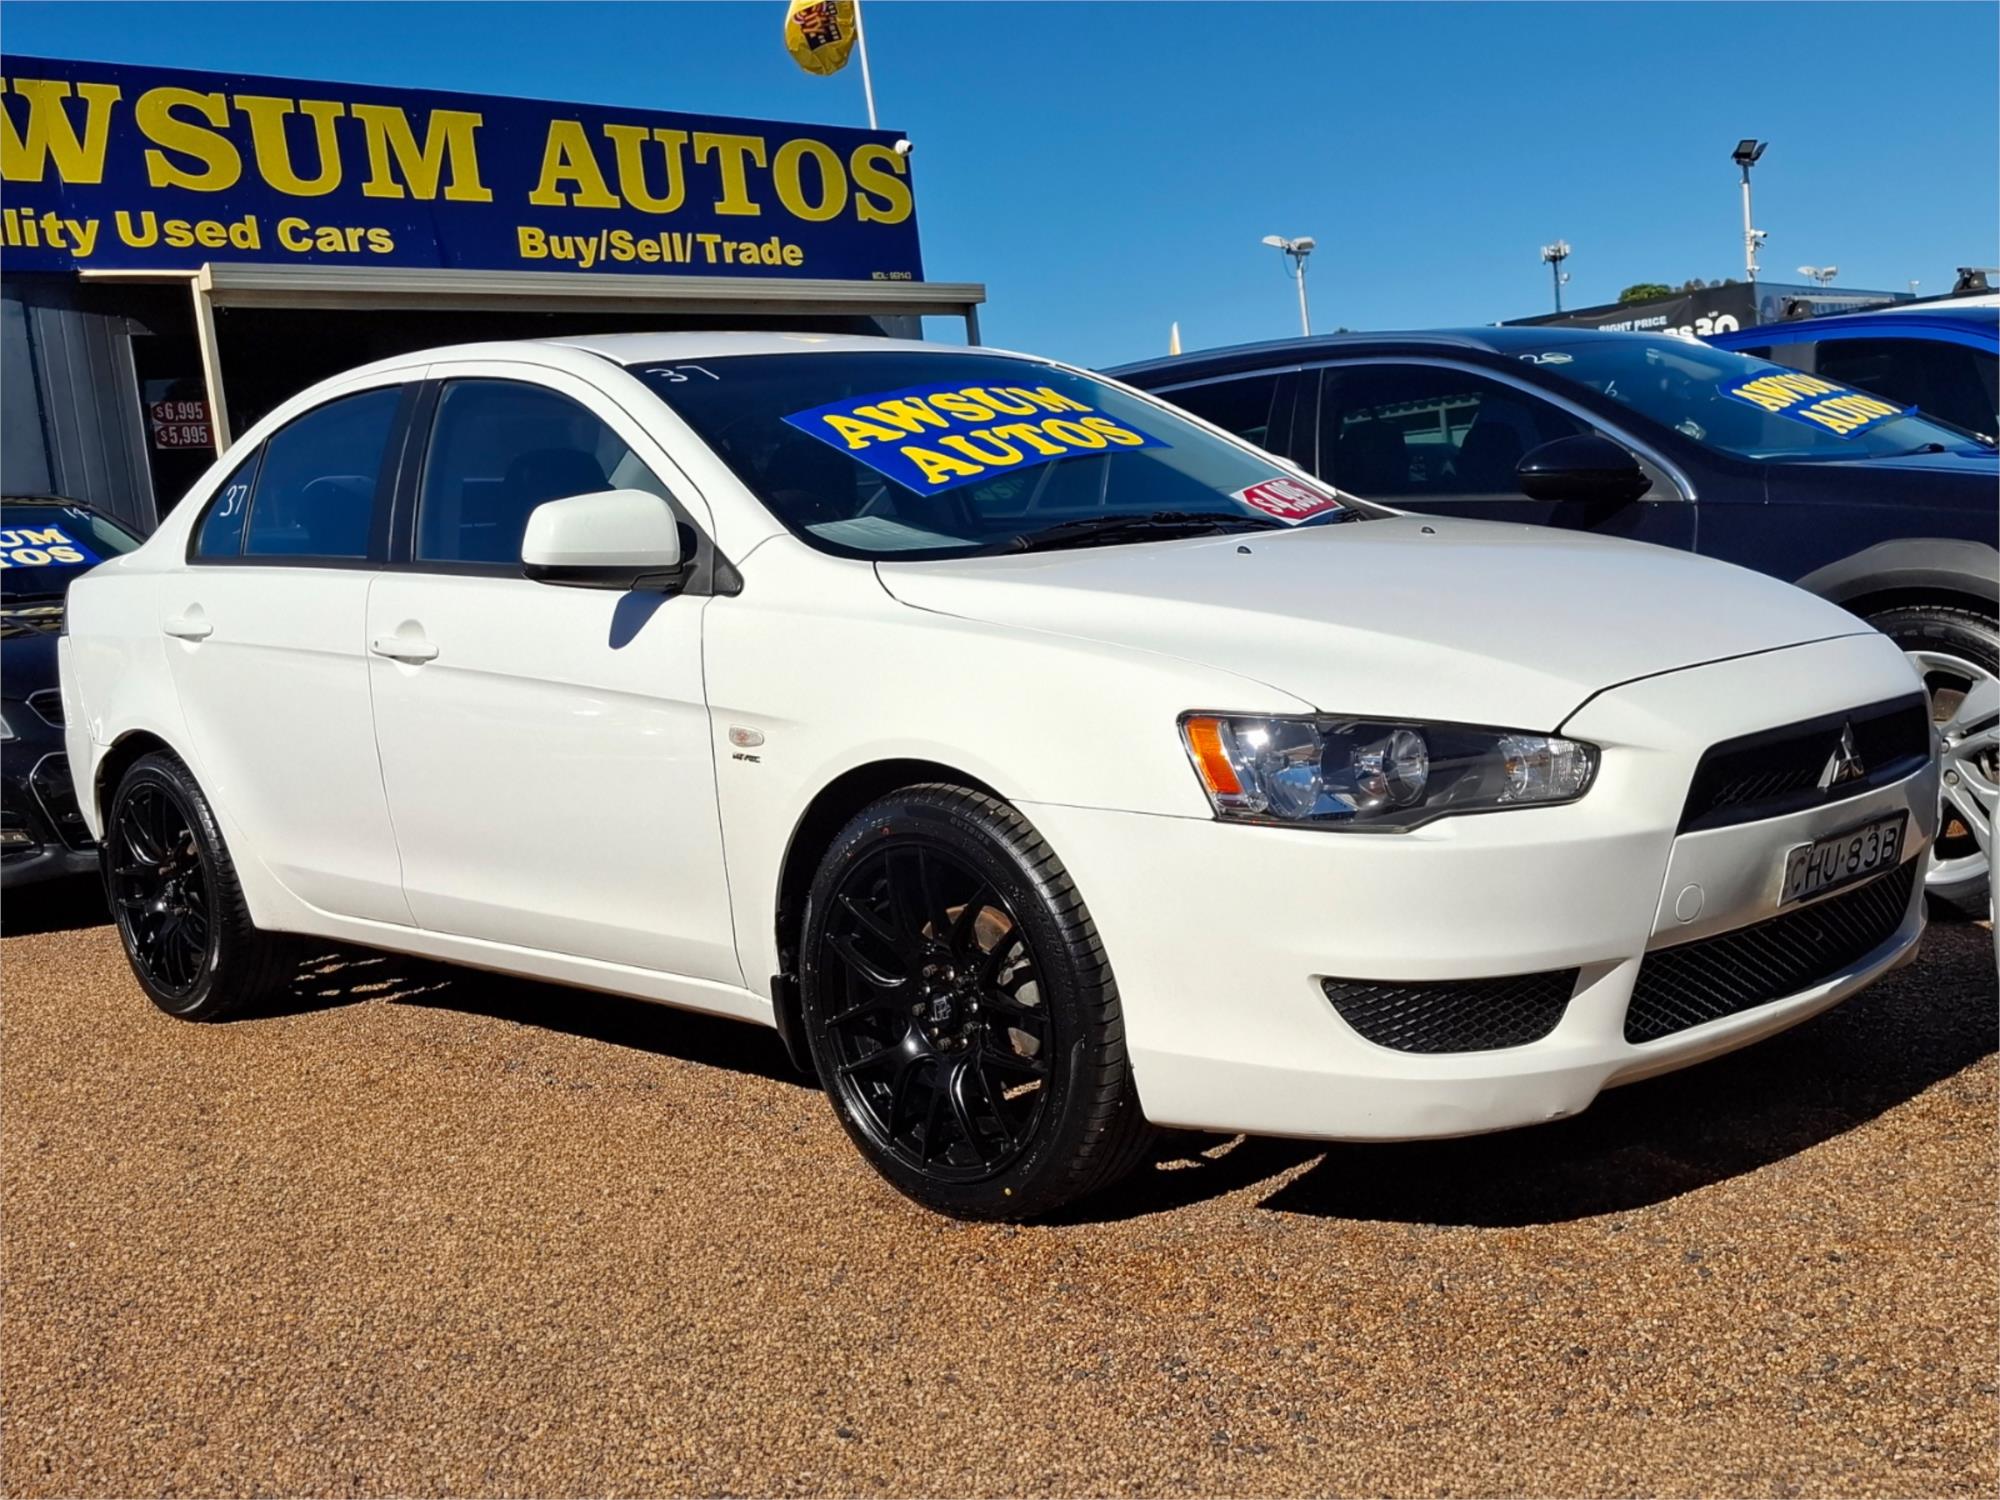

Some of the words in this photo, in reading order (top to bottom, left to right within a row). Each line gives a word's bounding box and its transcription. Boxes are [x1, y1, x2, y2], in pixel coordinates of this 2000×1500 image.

[529, 119, 913, 225] AUTOS
[1, 207, 99, 257] lity
[115, 210, 261, 250] Used
[277, 216, 395, 254] Cars
[517, 226, 804, 268] Buy/Sell/Trade
[1634, 315, 1668, 332] PRICE
[645, 364, 720, 382] 37
[155, 402, 204, 421] $6,995
[822, 386, 1094, 450] AWSUM
[160, 425, 208, 445] $5,995
[900, 416, 1145, 485] AUTOS
[219, 484, 248, 517] 37
